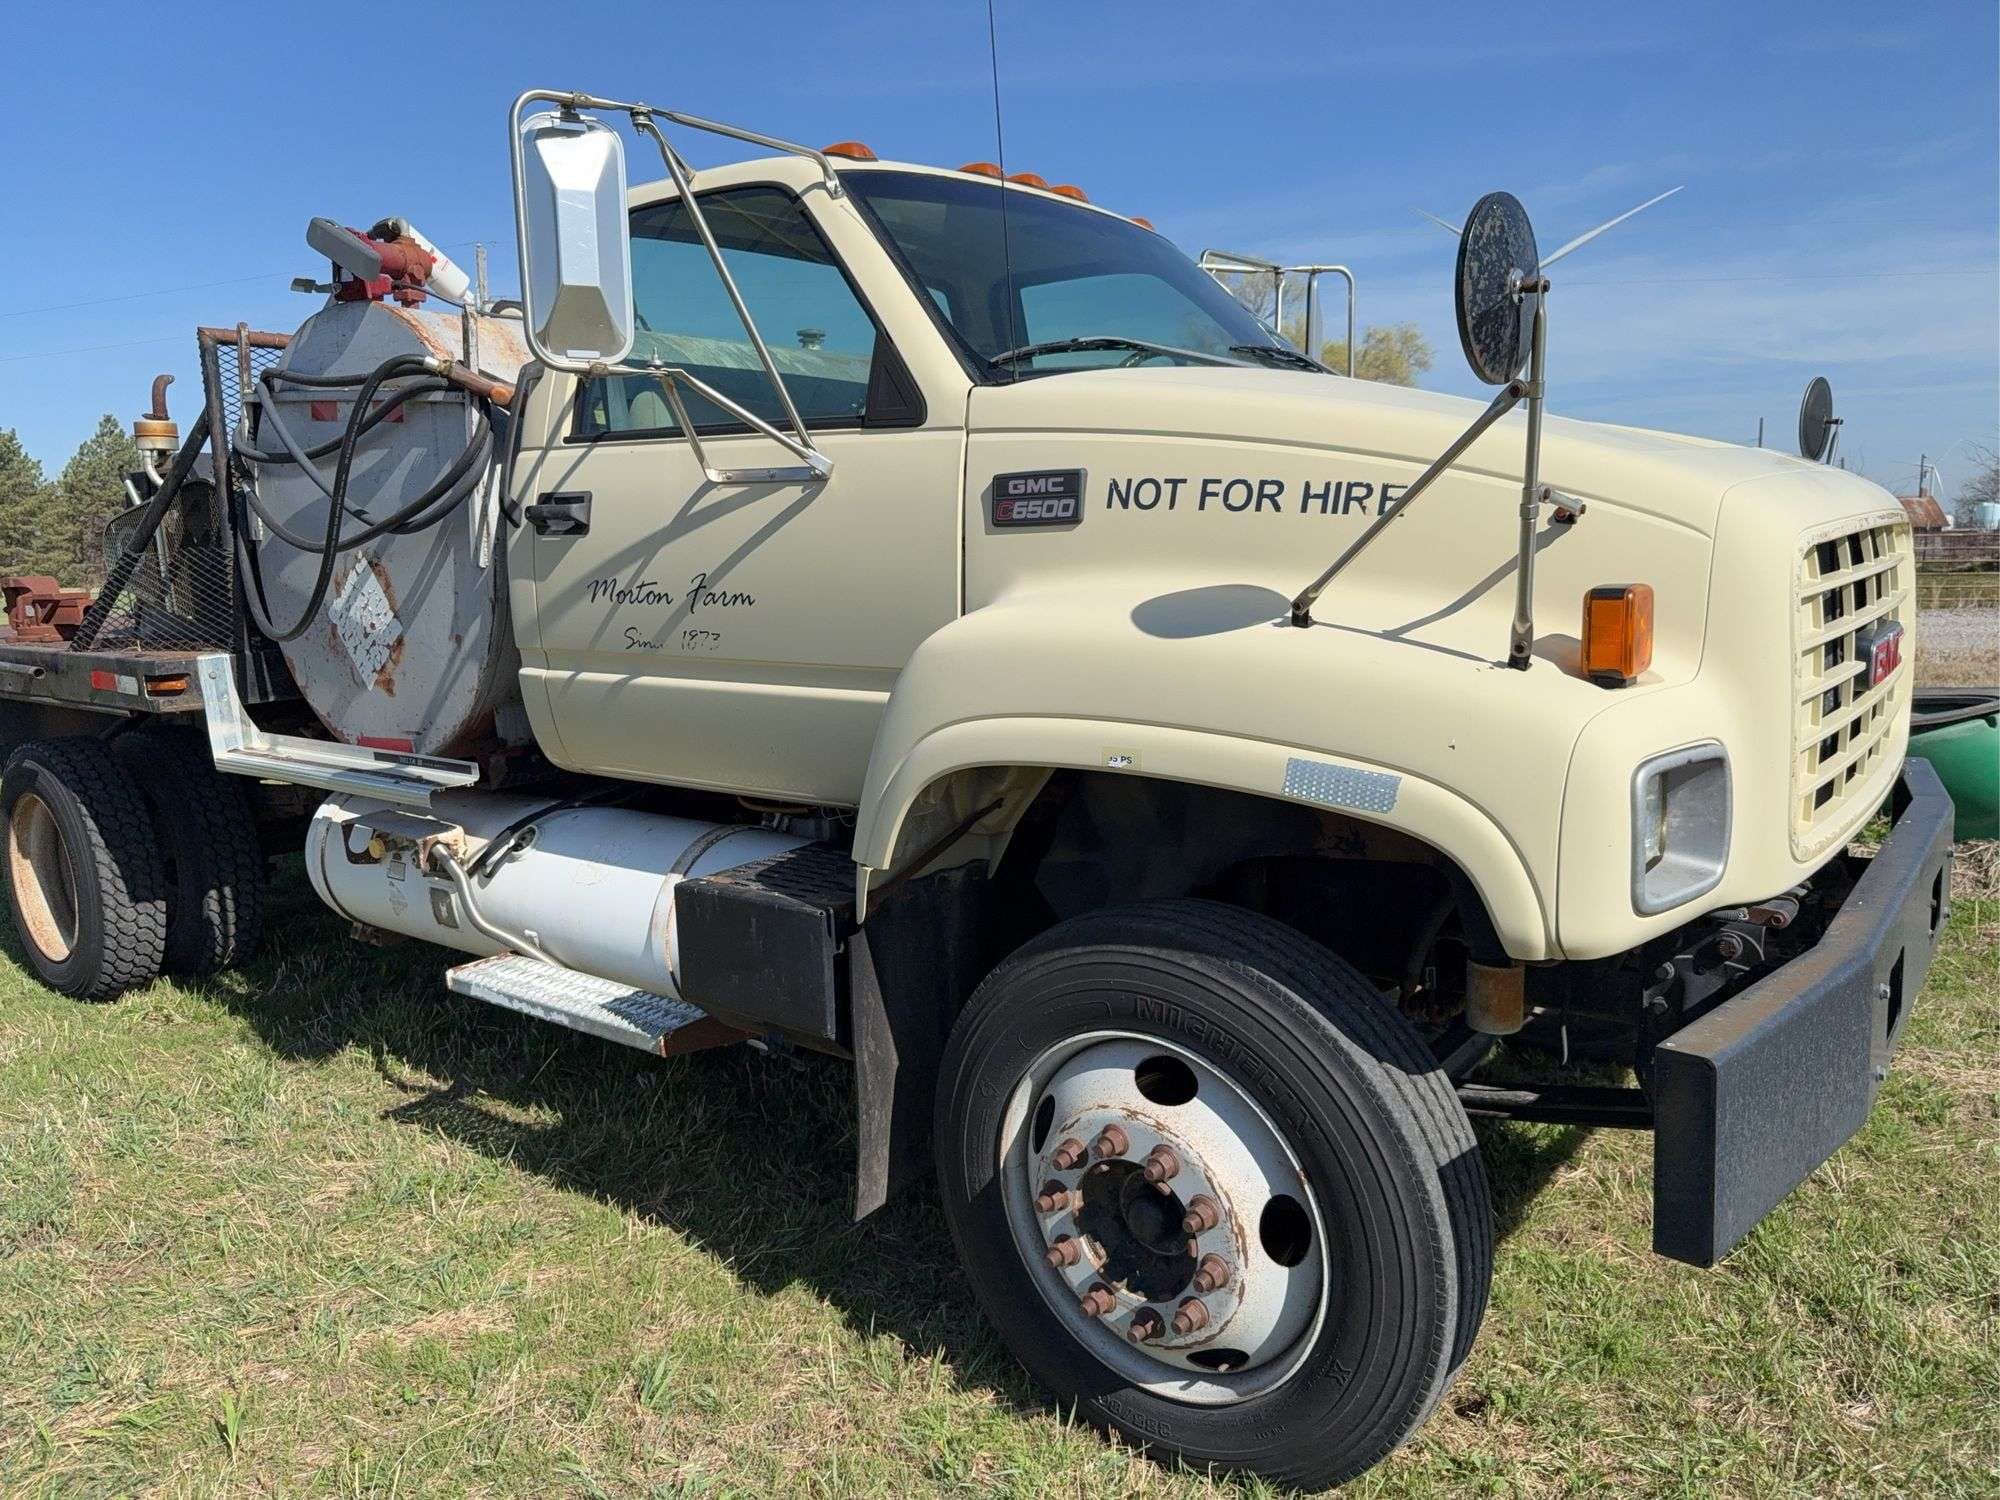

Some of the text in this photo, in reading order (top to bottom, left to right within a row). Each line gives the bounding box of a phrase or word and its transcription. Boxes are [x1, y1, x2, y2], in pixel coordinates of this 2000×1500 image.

[1008, 477, 1064, 495] GMC
[1106, 477, 1408, 517] NOT FOR HIRE
[996, 498, 1075, 520] C6500
[587, 573, 756, 614] Morton Farm
